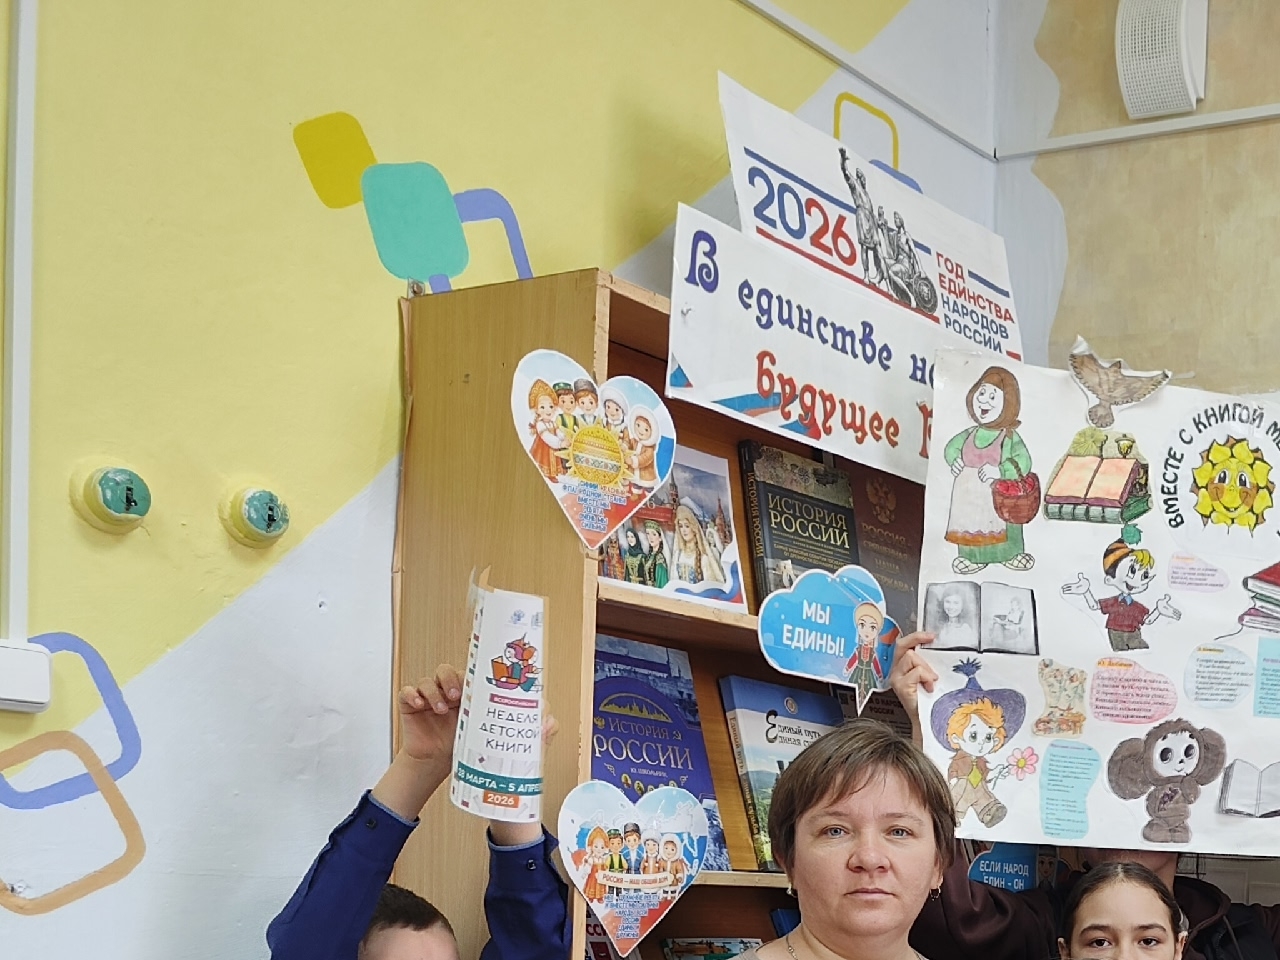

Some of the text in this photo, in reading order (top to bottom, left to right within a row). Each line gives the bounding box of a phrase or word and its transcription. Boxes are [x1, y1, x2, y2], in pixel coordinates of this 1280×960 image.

[748, 166, 857, 267] 2026
[936, 251, 965, 281] ГОД
[685, 230, 719, 293] В
[738, 278, 893, 372] единстве
[938, 273, 1015, 324] ЕДИНСТВА
[941, 297, 1009, 339] НАРОДОВ
[944, 317, 1003, 354] РОССИИ
[755, 350, 899, 448] будущее
[1160, 447, 1185, 529] ВМЕСТЕ
[1179, 428, 1193, 445] С
[1192, 402, 1264, 434] КНИГОЙ
[748, 473, 763, 557] ИСТОРИЯ РОССИИ
[768, 493, 847, 530] ИСТОРИЯ
[769, 509, 849, 548] РОССИИ
[803, 600, 830, 625] МЫ
[783, 625, 845, 657] ЕДИНЫ!
[479, 723, 539, 739] ДЕТСКОЙ
[487, 708, 538, 723] НЕДЕЛЯ
[485, 738, 532, 753] КНИГИ
[594, 734, 694, 770] РОССИИ
[466, 771, 495, 788] МАРТА
[508, 782, 515, 792] 5
[518, 782, 543, 793] АПРЕ
[487, 793, 514, 806] 2026
[980, 861, 1029, 876] ЕСЛИ НАРОД
[1014, 879, 1024, 889] ОН
